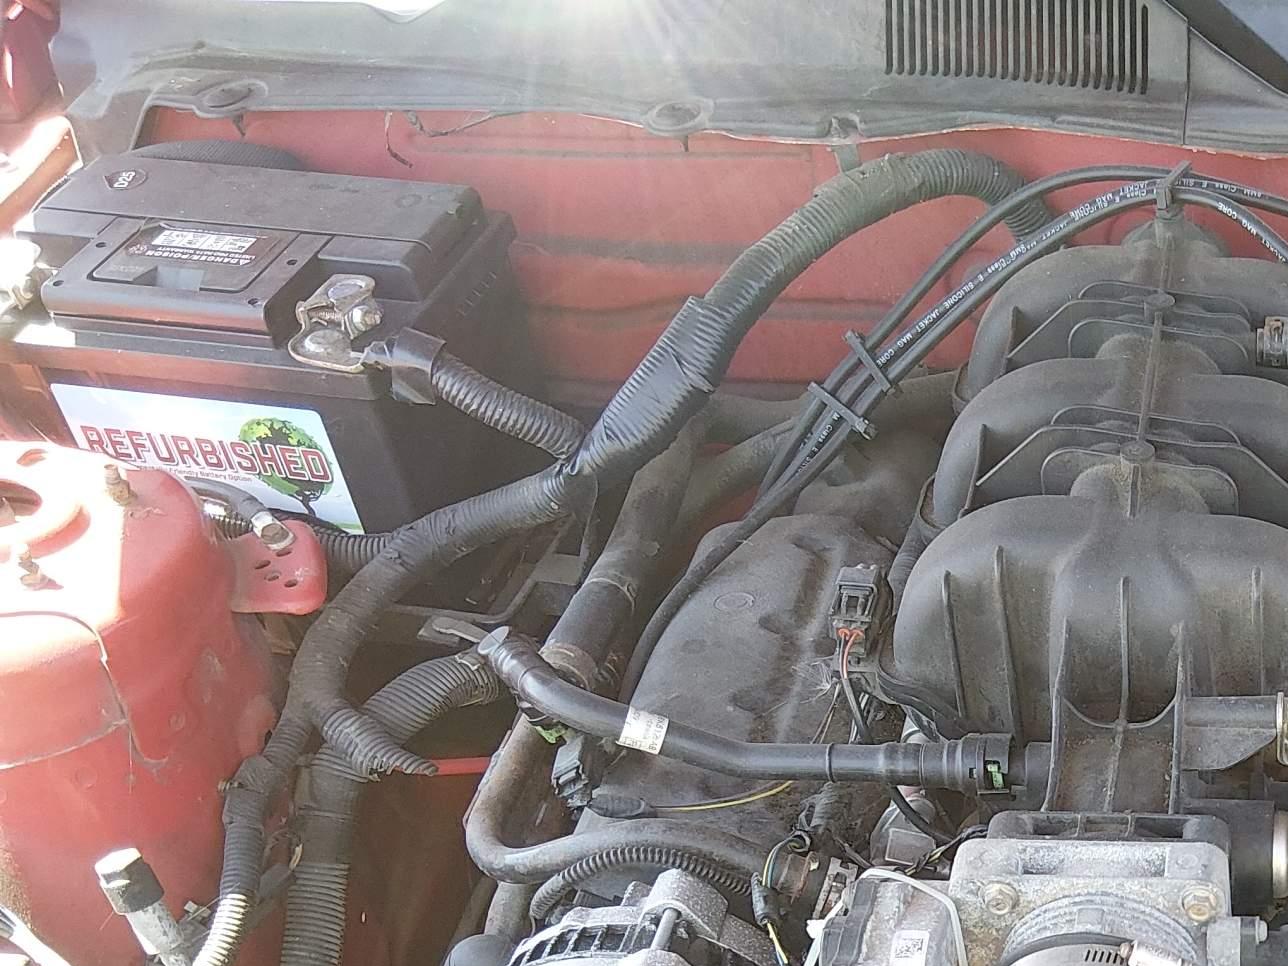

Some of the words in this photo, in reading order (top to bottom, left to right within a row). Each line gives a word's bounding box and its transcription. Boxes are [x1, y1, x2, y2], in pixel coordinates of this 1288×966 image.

[113, 171, 136, 189] D25
[942, 281, 975, 310] SILICONE
[915, 308, 940, 334] JACKET
[896, 333, 913, 349] MAG
[876, 349, 896, 369] CORE
[80, 425, 333, 483] REFURBISHED
